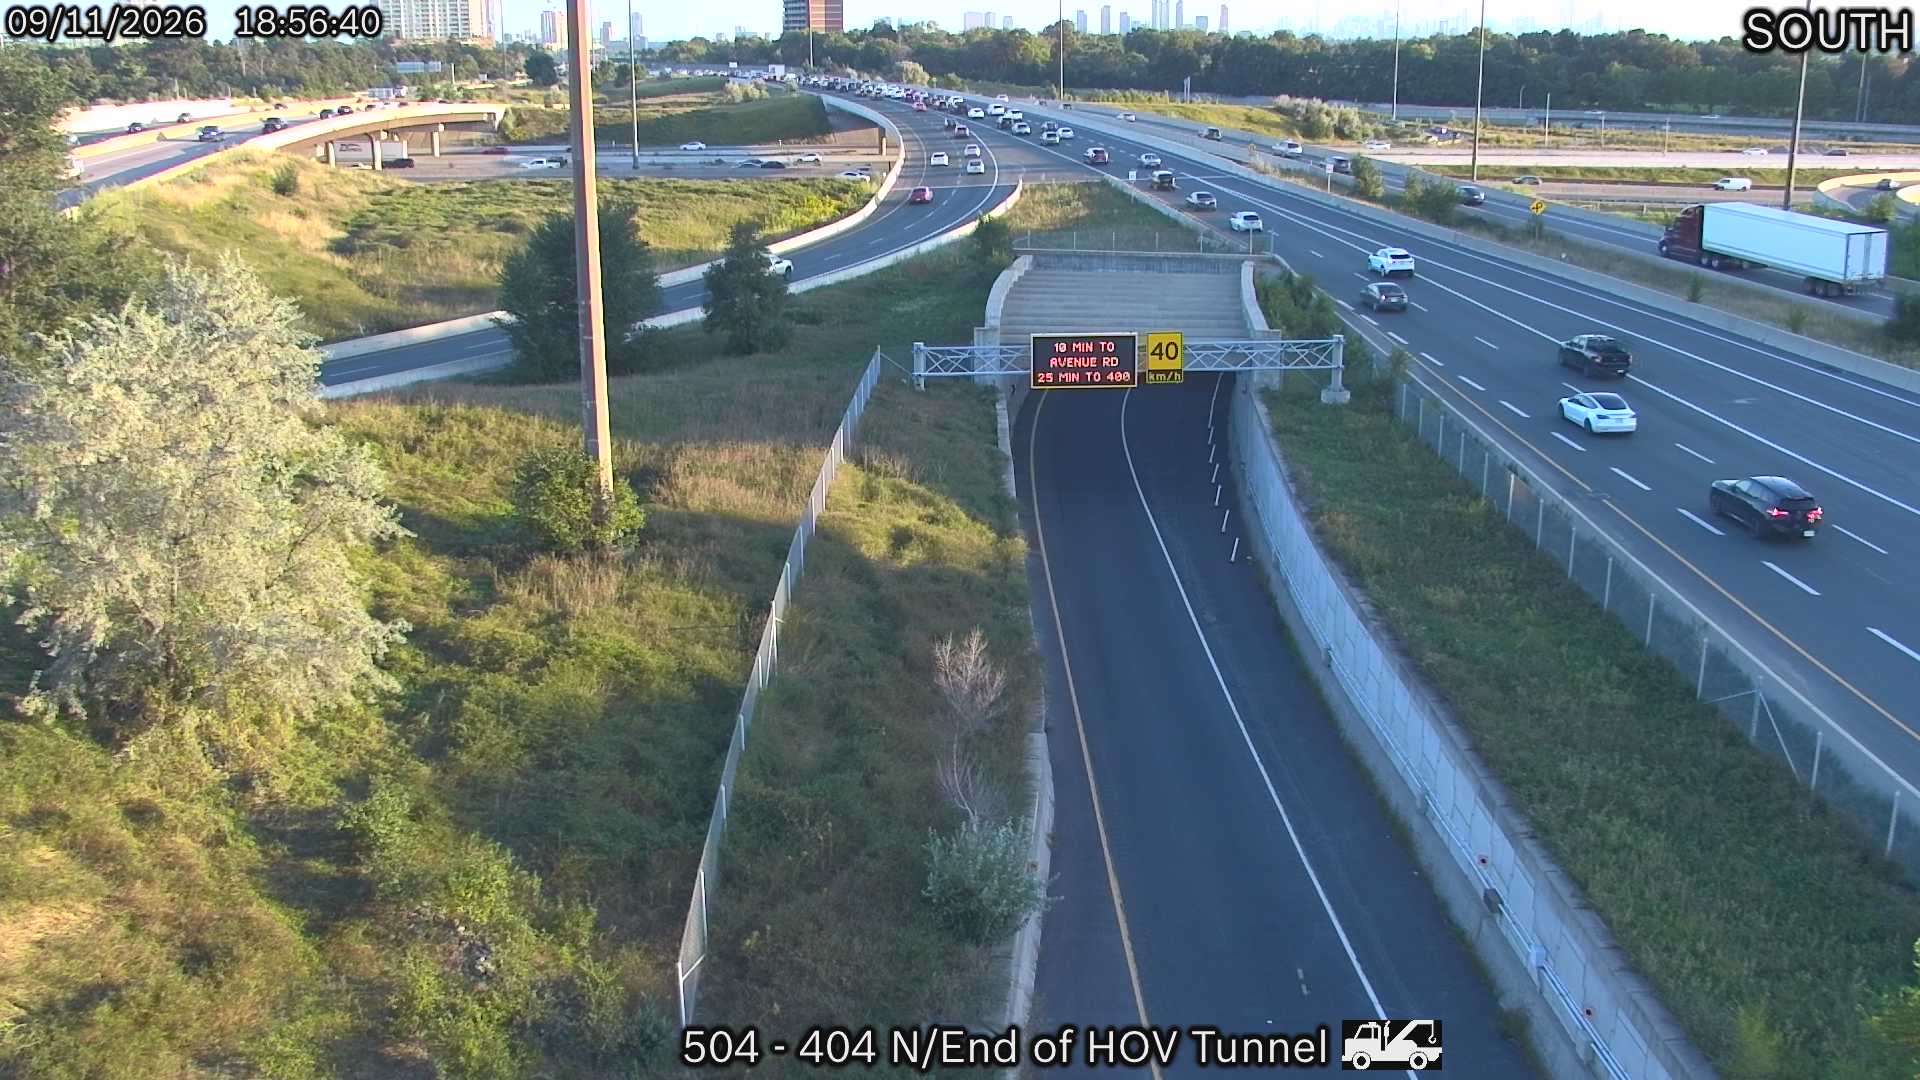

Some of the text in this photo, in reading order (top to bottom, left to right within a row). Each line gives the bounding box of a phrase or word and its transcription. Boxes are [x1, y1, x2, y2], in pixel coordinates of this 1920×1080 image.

[1054, 342, 1115, 353] 10 MIN TO
[1150, 342, 1179, 360] 40
[1050, 357, 1119, 368] AVENUE RD
[1037, 371, 1130, 383] 25 MIN TO 400
[1150, 371, 1181, 381] km/h
